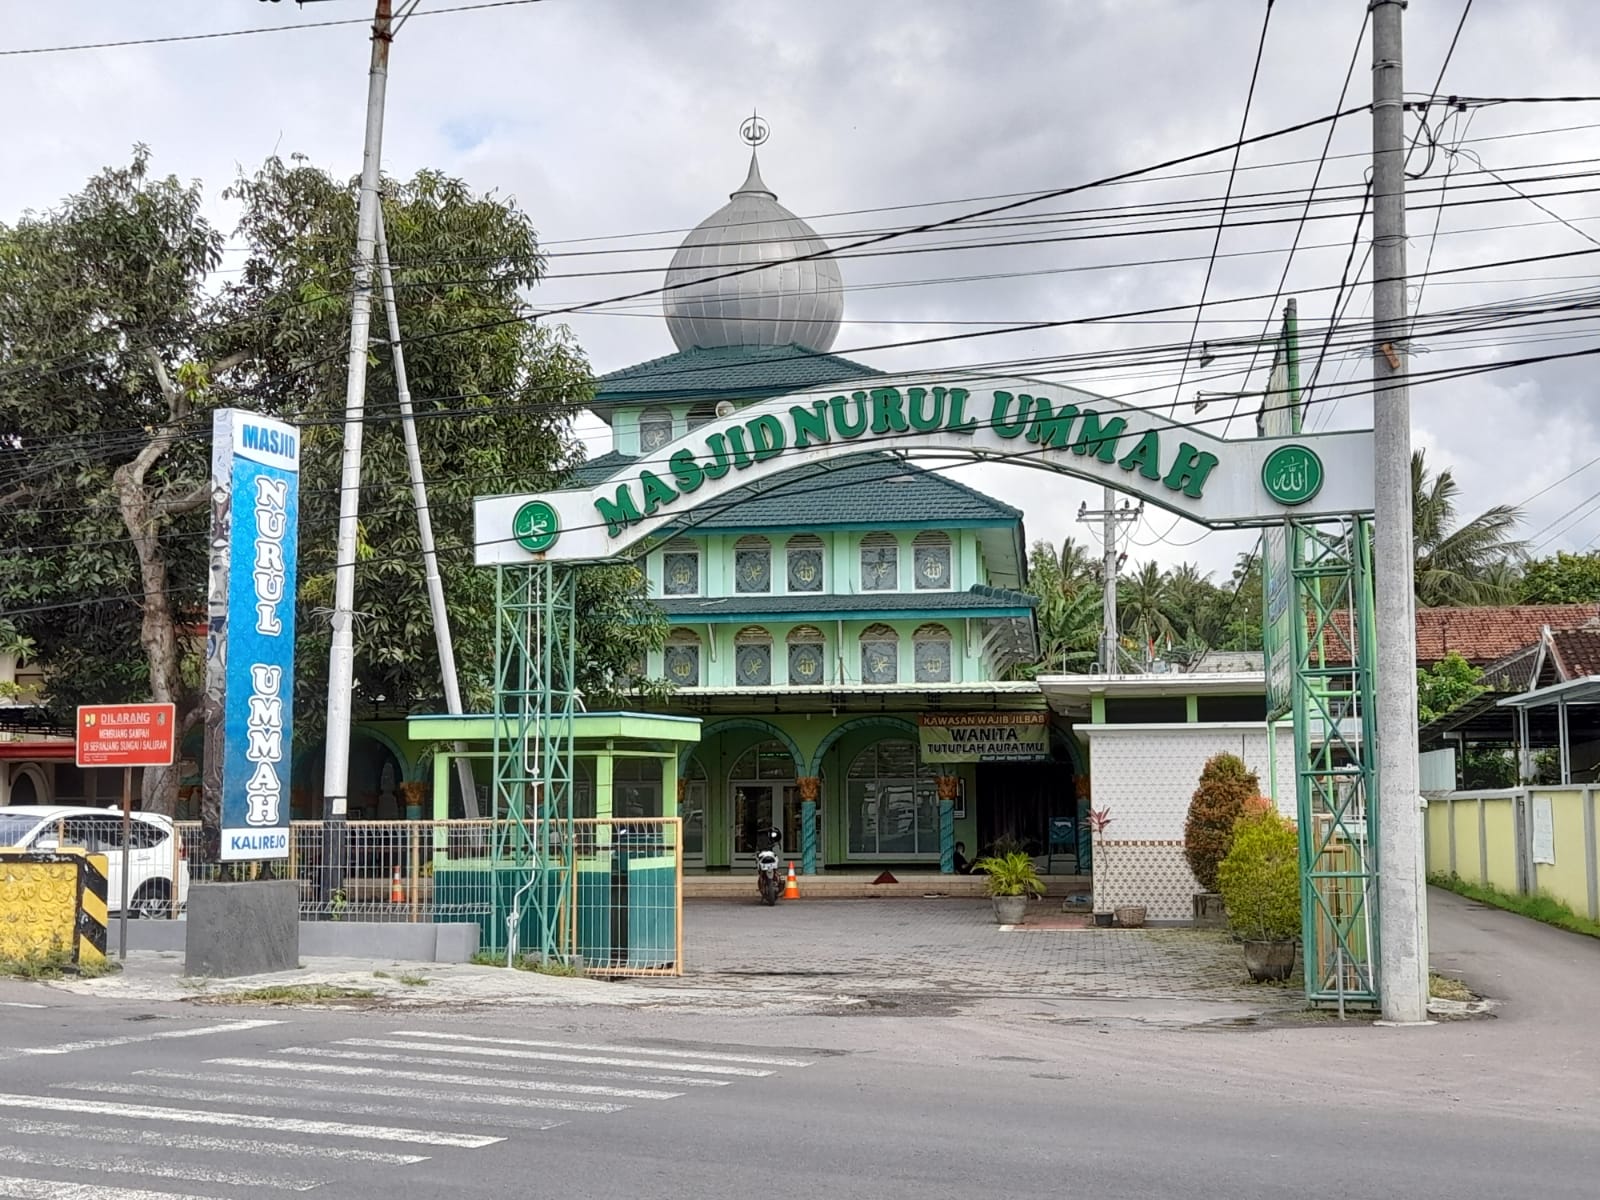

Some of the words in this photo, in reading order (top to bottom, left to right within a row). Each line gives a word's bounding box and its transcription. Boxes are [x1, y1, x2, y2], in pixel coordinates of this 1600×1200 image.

[242, 424, 295, 460] MASJID
[598, 413, 786, 539] MASJID
[790, 386, 977, 448] NURUL
[993, 390, 1219, 498] UMMAH
[255, 475, 287, 637] NURUL
[100, 712, 151, 724] DILARANG
[923, 715, 975, 725] KAWASAN
[977, 715, 1009, 725] WAJIB
[1011, 714, 1045, 724] JILBAB
[950, 728, 1018, 741] WANITA
[247, 664, 282, 825] UMMAH
[927, 743, 986, 753] TUTUPLAH
[988, 742, 1044, 752] AURATMU
[231, 834, 286, 850] KALIREJO
